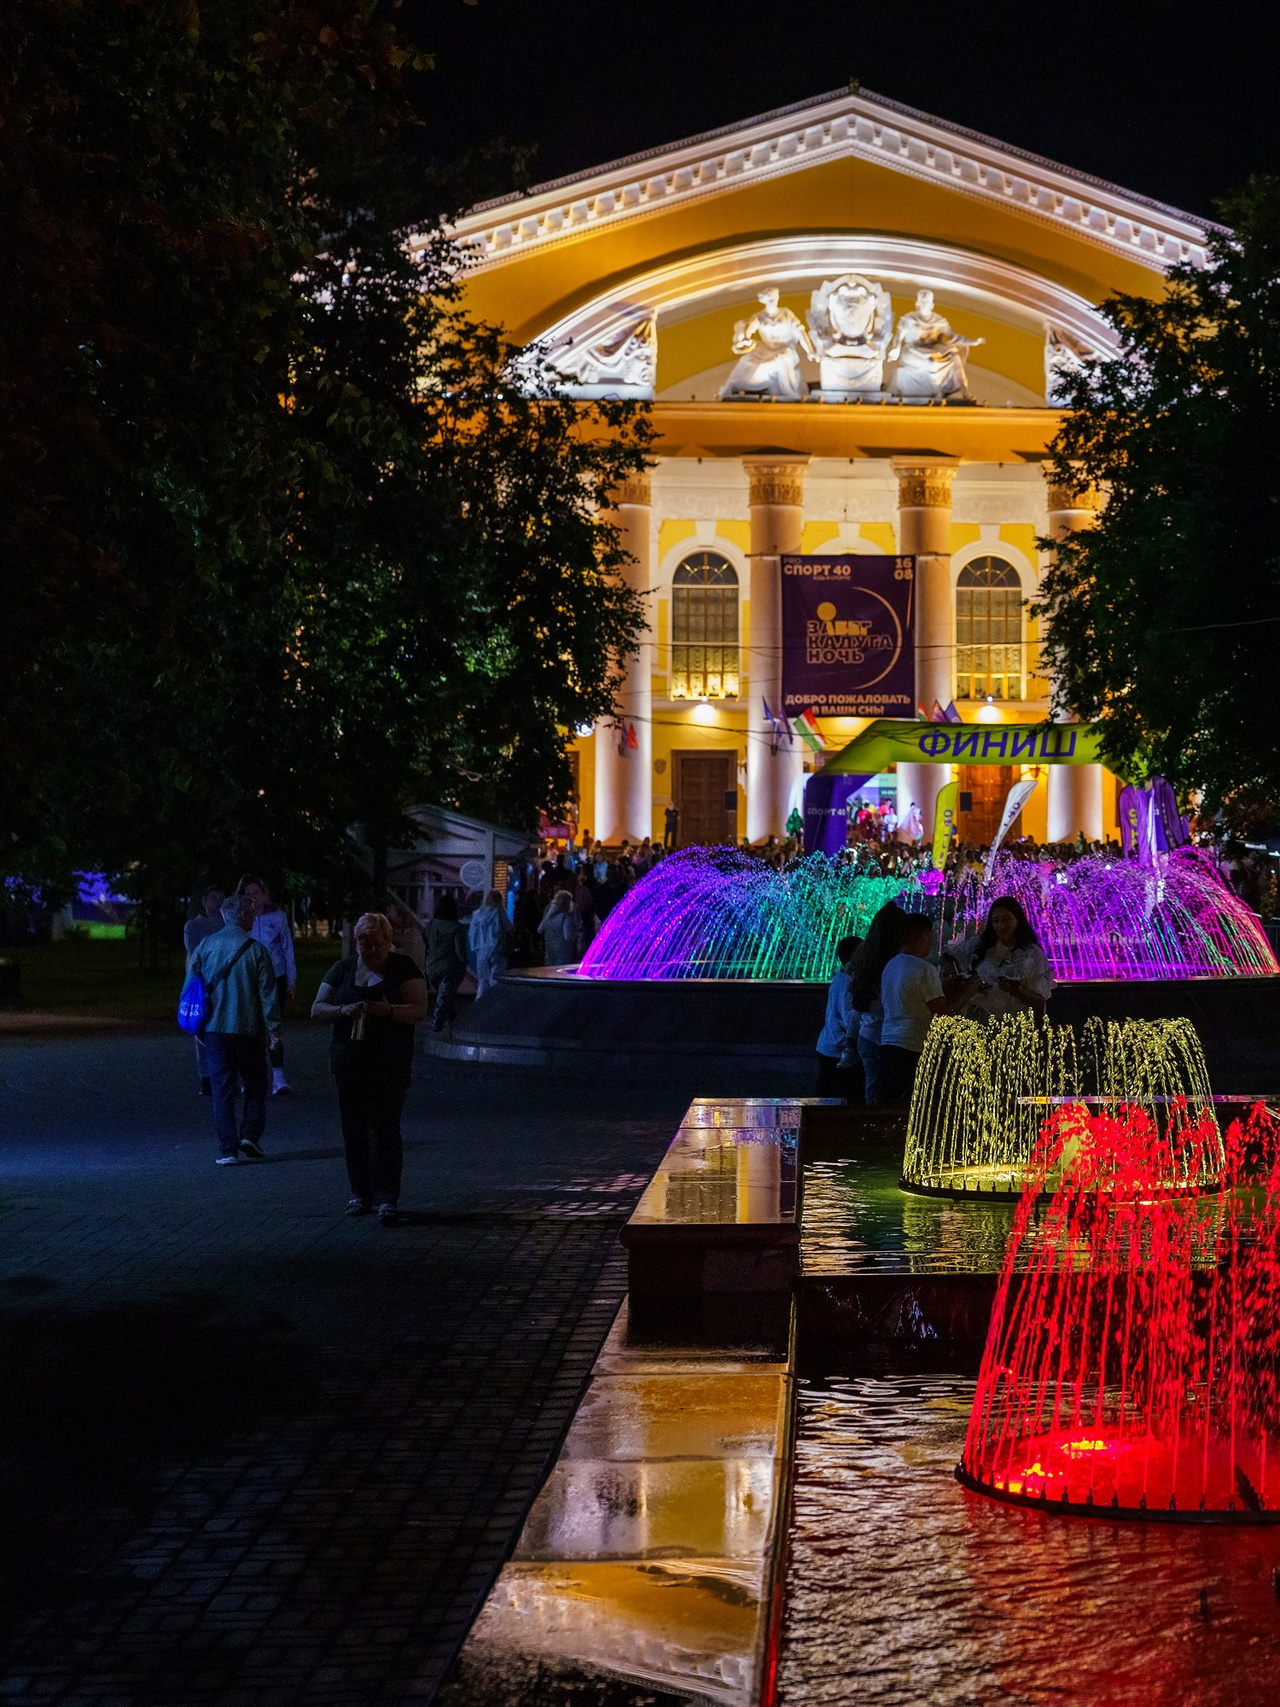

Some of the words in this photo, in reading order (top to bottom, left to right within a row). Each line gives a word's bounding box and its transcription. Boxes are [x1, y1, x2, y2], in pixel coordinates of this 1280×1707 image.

[894, 557, 912, 569] 16
[784, 564, 831, 576] СПОРТ
[832, 564, 851, 576] 40
[893, 568, 914, 581] 08
[806, 634, 893, 650] КАЛУГА
[806, 648, 865, 664] НОЧЬ
[785, 694, 828, 706] ДОБРО
[828, 694, 911, 705] ПОЖАЛОВАТЬ
[821, 705, 857, 715] ВАШИ
[858, 705, 885, 715] СНЫ
[918, 728, 1077, 758] ФИНИШ
